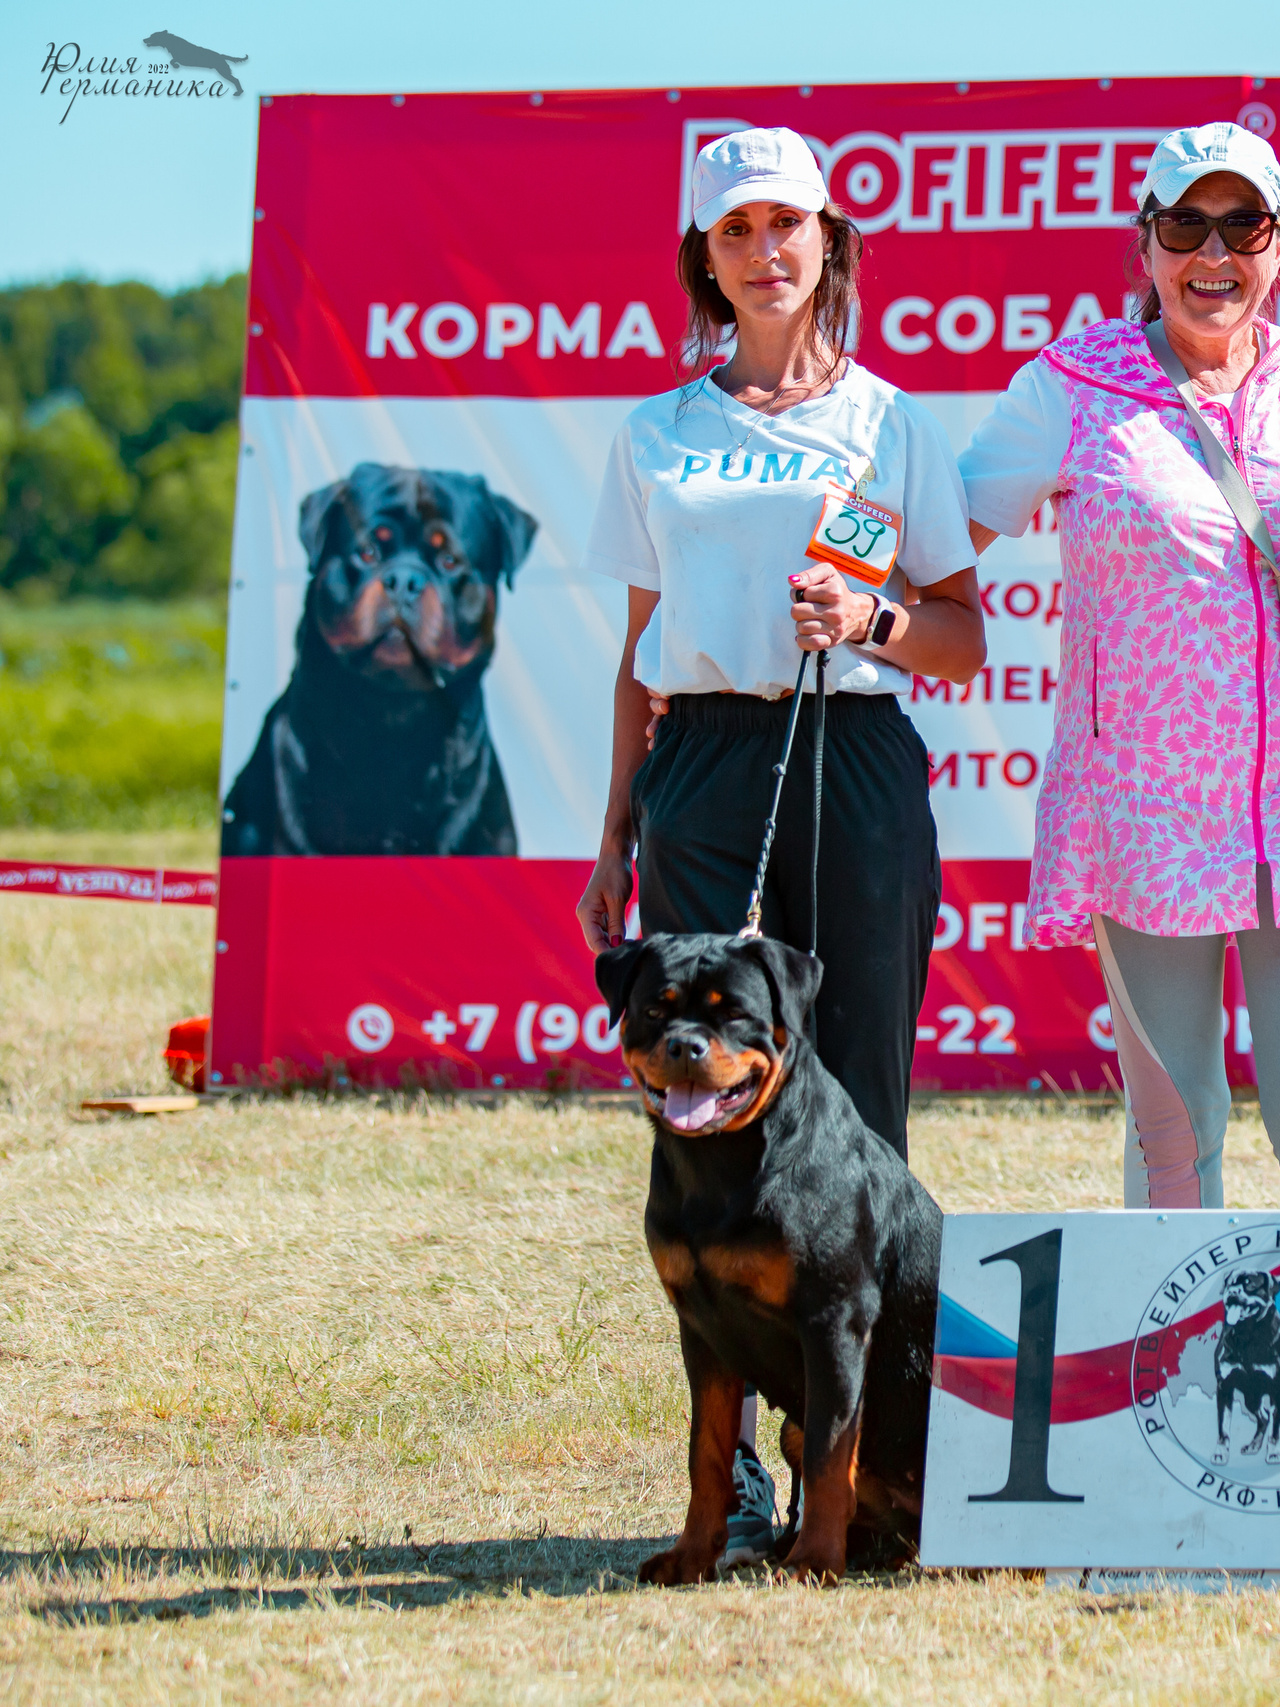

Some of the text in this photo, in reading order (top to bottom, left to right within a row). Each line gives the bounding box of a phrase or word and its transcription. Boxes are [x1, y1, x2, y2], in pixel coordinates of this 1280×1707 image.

[680, 118, 1168, 238] OFIFEE
[367, 302, 665, 360] КОРМА
[678, 453, 849, 486] PUMA
[824, 504, 886, 559] 39
[929, 751, 1038, 789] ИТО
[422, 1001, 1017, 1064] +7 (90 -22
[967, 1228, 1085, 1503] 1
[1136, 1235, 1252, 1436] РОТВЕЙЛЕР
